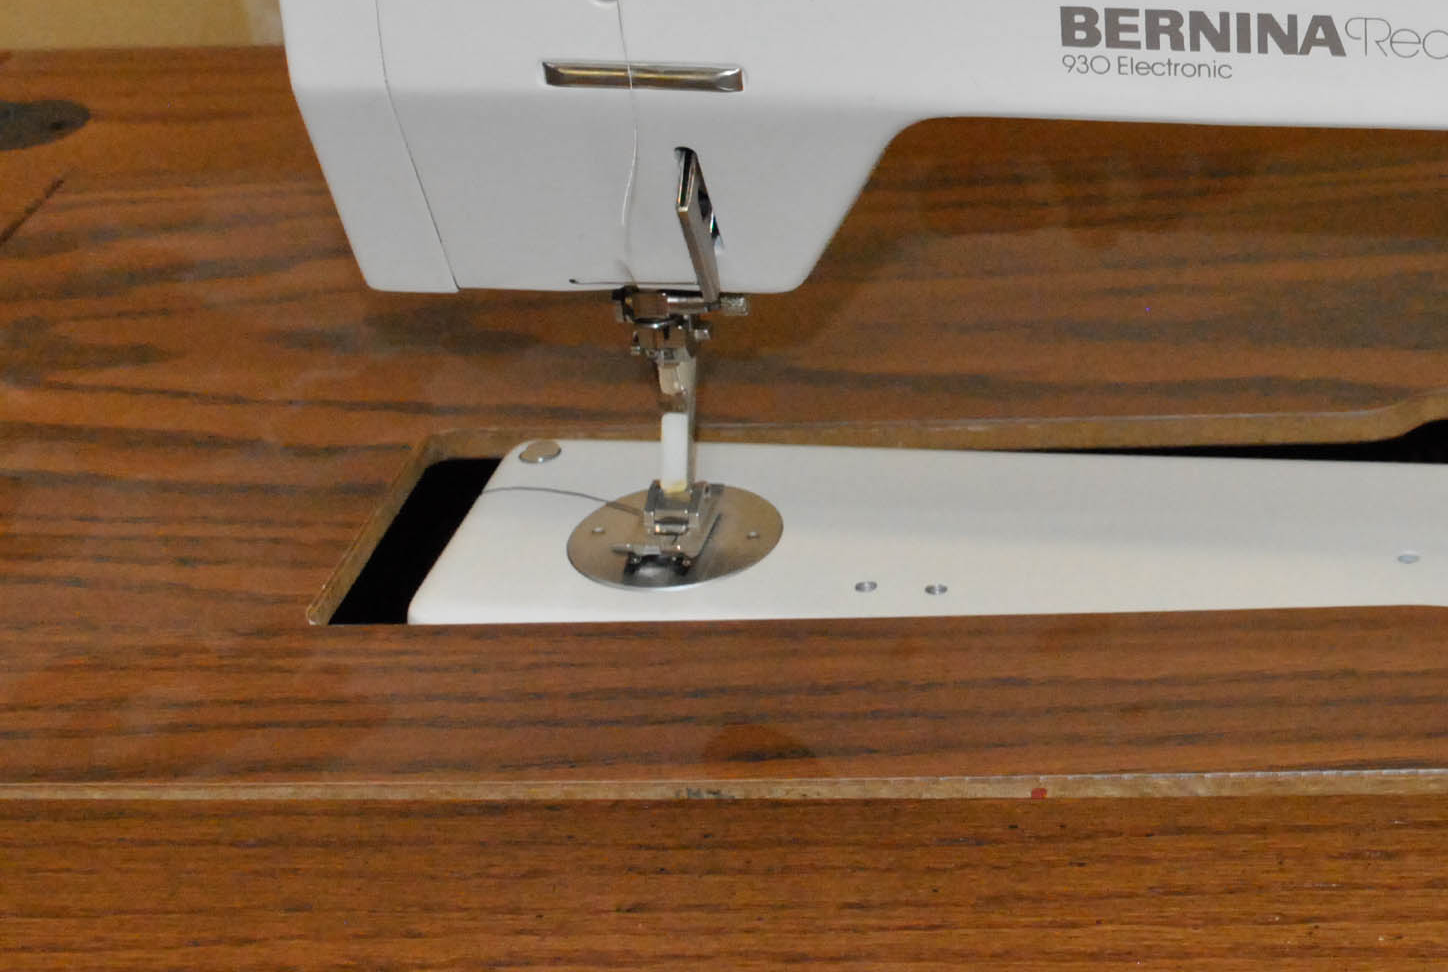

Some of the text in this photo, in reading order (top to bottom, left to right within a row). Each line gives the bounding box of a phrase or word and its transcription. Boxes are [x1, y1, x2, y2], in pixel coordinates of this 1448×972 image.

[1059, 5, 1347, 58] BERNINA
[1061, 53, 1233, 81] 930 Electronic
